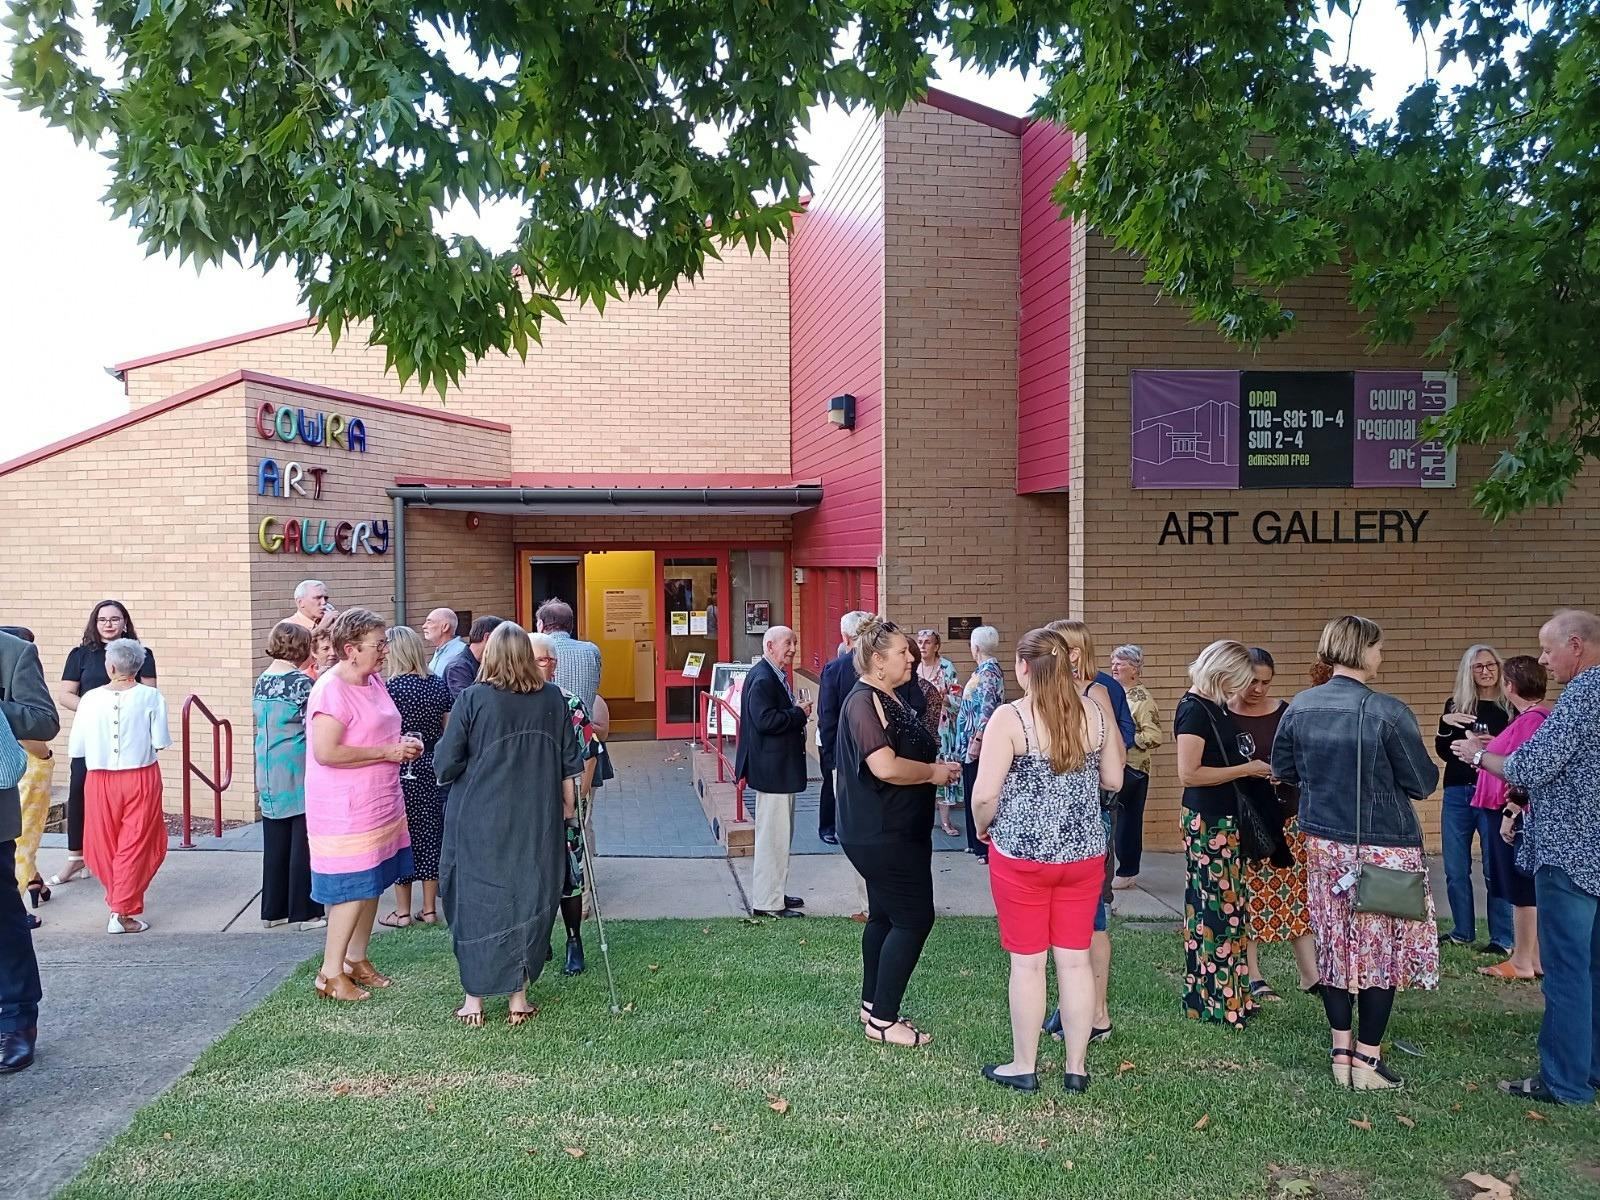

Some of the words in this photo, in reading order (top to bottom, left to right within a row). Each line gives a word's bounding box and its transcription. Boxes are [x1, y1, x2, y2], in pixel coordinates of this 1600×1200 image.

[1369, 389, 1416, 411] cowra
[256, 402, 367, 454] COWRA
[1357, 419, 1416, 441] regional
[1422, 379, 1447, 481] galery
[1248, 453, 1289, 466] admission
[1389, 448, 1416, 470] art
[257, 457, 328, 500] ART
[258, 516, 389, 556] GALLERY
[1158, 510, 1239, 545] ART
[1252, 509, 1430, 545] GALLERY
